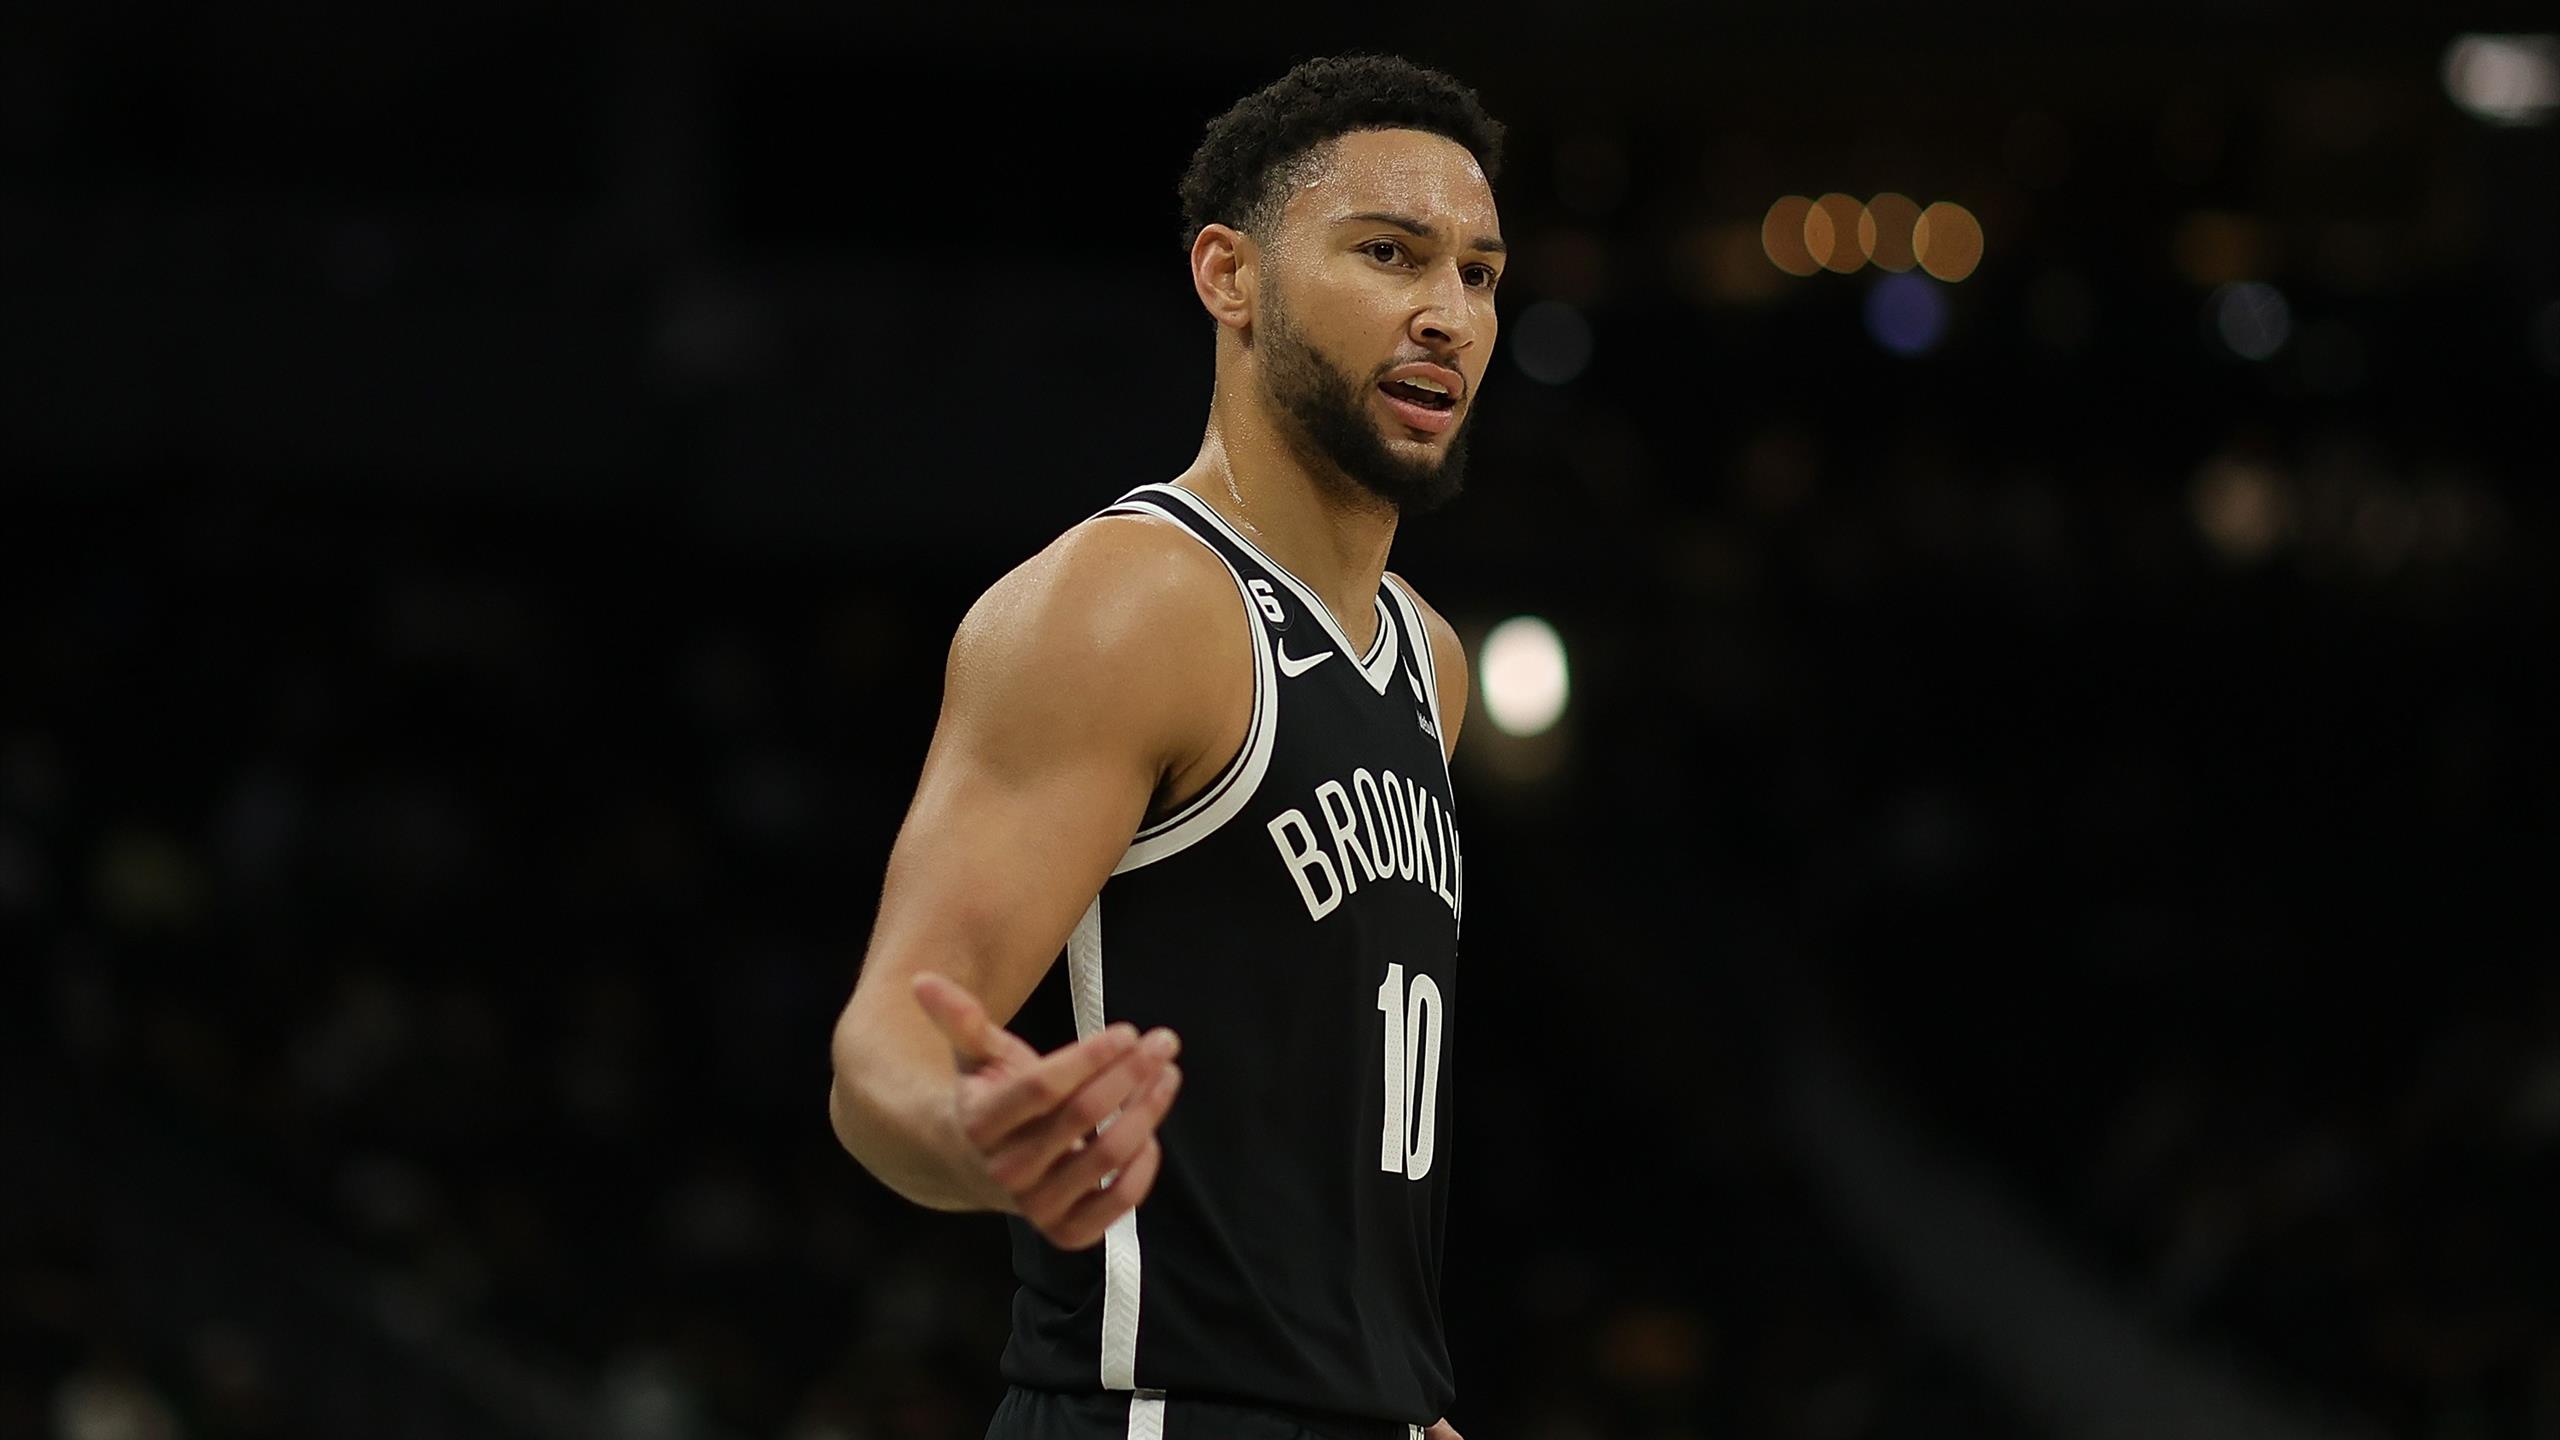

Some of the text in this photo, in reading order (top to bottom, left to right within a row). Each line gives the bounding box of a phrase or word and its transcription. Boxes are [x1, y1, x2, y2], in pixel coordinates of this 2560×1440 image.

[1247, 579, 1285, 623] 6
[1267, 767, 1462, 940] BROOKLY
[1377, 962, 1443, 1181] 10
